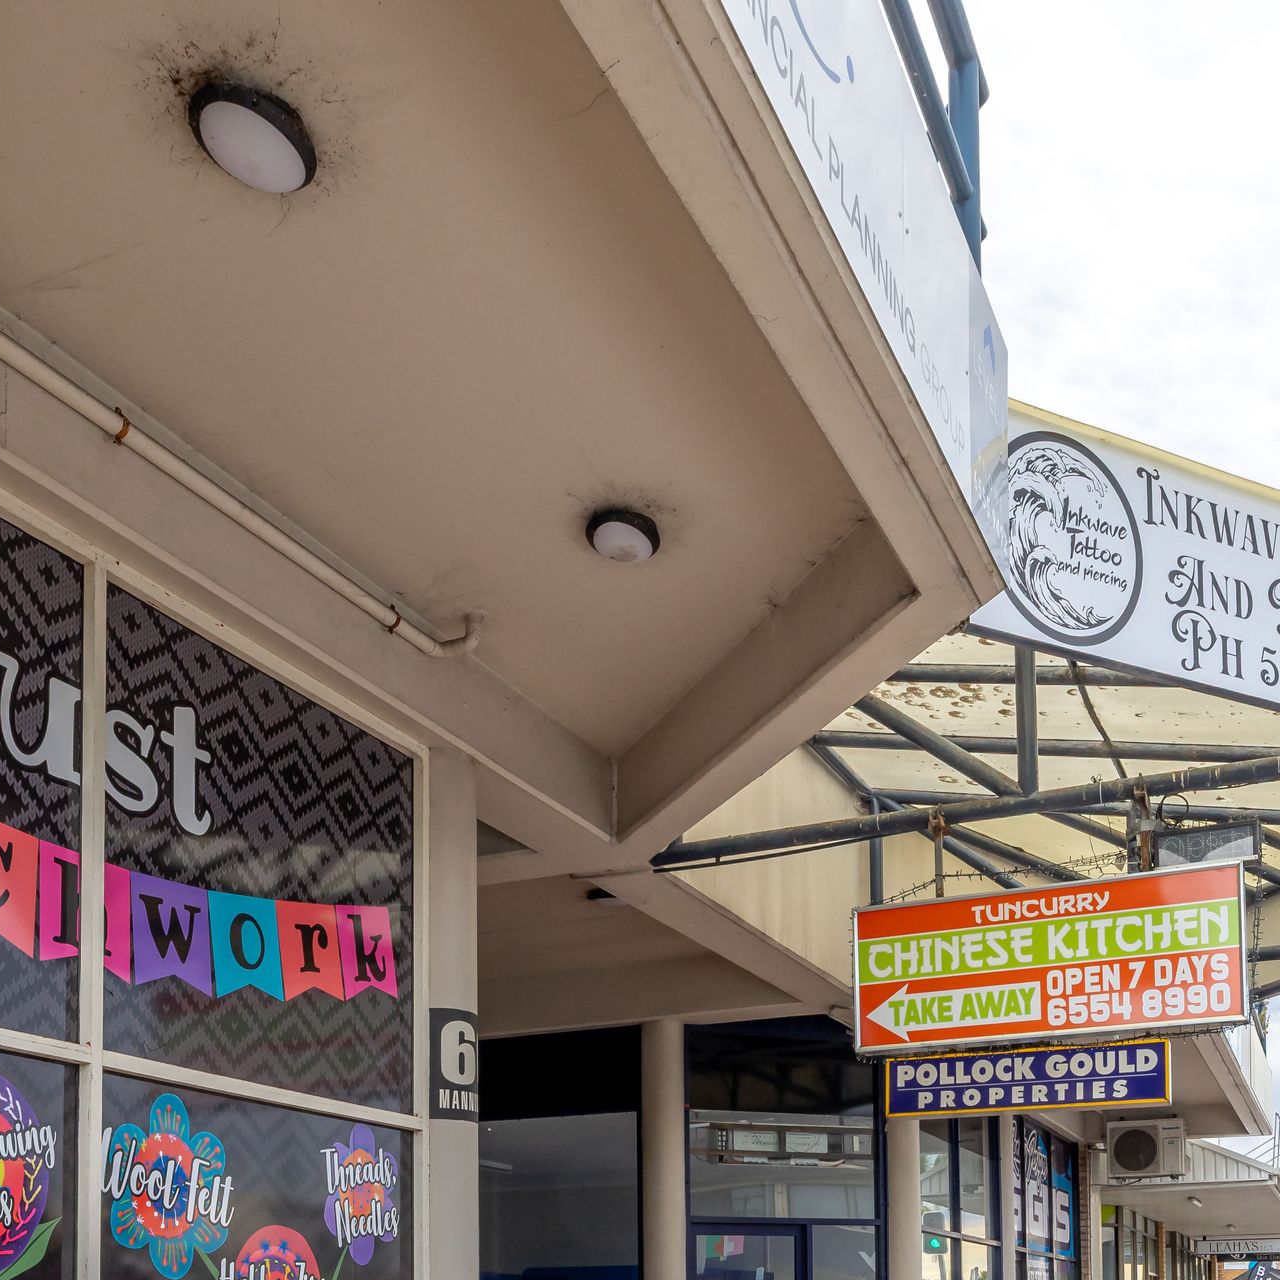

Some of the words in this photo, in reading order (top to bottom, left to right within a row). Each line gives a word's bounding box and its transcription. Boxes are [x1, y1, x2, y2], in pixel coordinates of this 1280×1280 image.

[746, 0, 822, 162] NCIAL
[829, 134, 917, 359] PLANNING
[920, 342, 966, 454] GROUP
[1061, 502, 1128, 541] Inkwave
[1067, 527, 1123, 567] Tattoo
[1057, 558, 1082, 576] and
[1082, 565, 1128, 593] piercing
[1165, 555, 1254, 621] AND
[1171, 609, 1245, 680] PH
[971, 891, 1110, 925] TUNCURRY
[868, 926, 1034, 978] CHINESE
[1047, 905, 1229, 961] KITCHEN
[1046, 963, 1120, 996] OPEN
[1128, 961, 1145, 991] 7
[1154, 953, 1229, 987] DAYS
[888, 995, 953, 1028] TAKE
[959, 986, 1037, 1021] AWAY
[1047, 989, 1133, 1027] 6554
[1142, 982, 1231, 1017] 8990
[896, 1054, 1036, 1089] POLLOCK
[1045, 1049, 1158, 1080] GOULD
[918, 1079, 1129, 1110] PROPERTIES
[100, 1126, 182, 1211] Wool
[182, 1158, 235, 1229] Felt
[319, 1146, 398, 1197] Threads,
[333, 1199, 401, 1249] Needles
